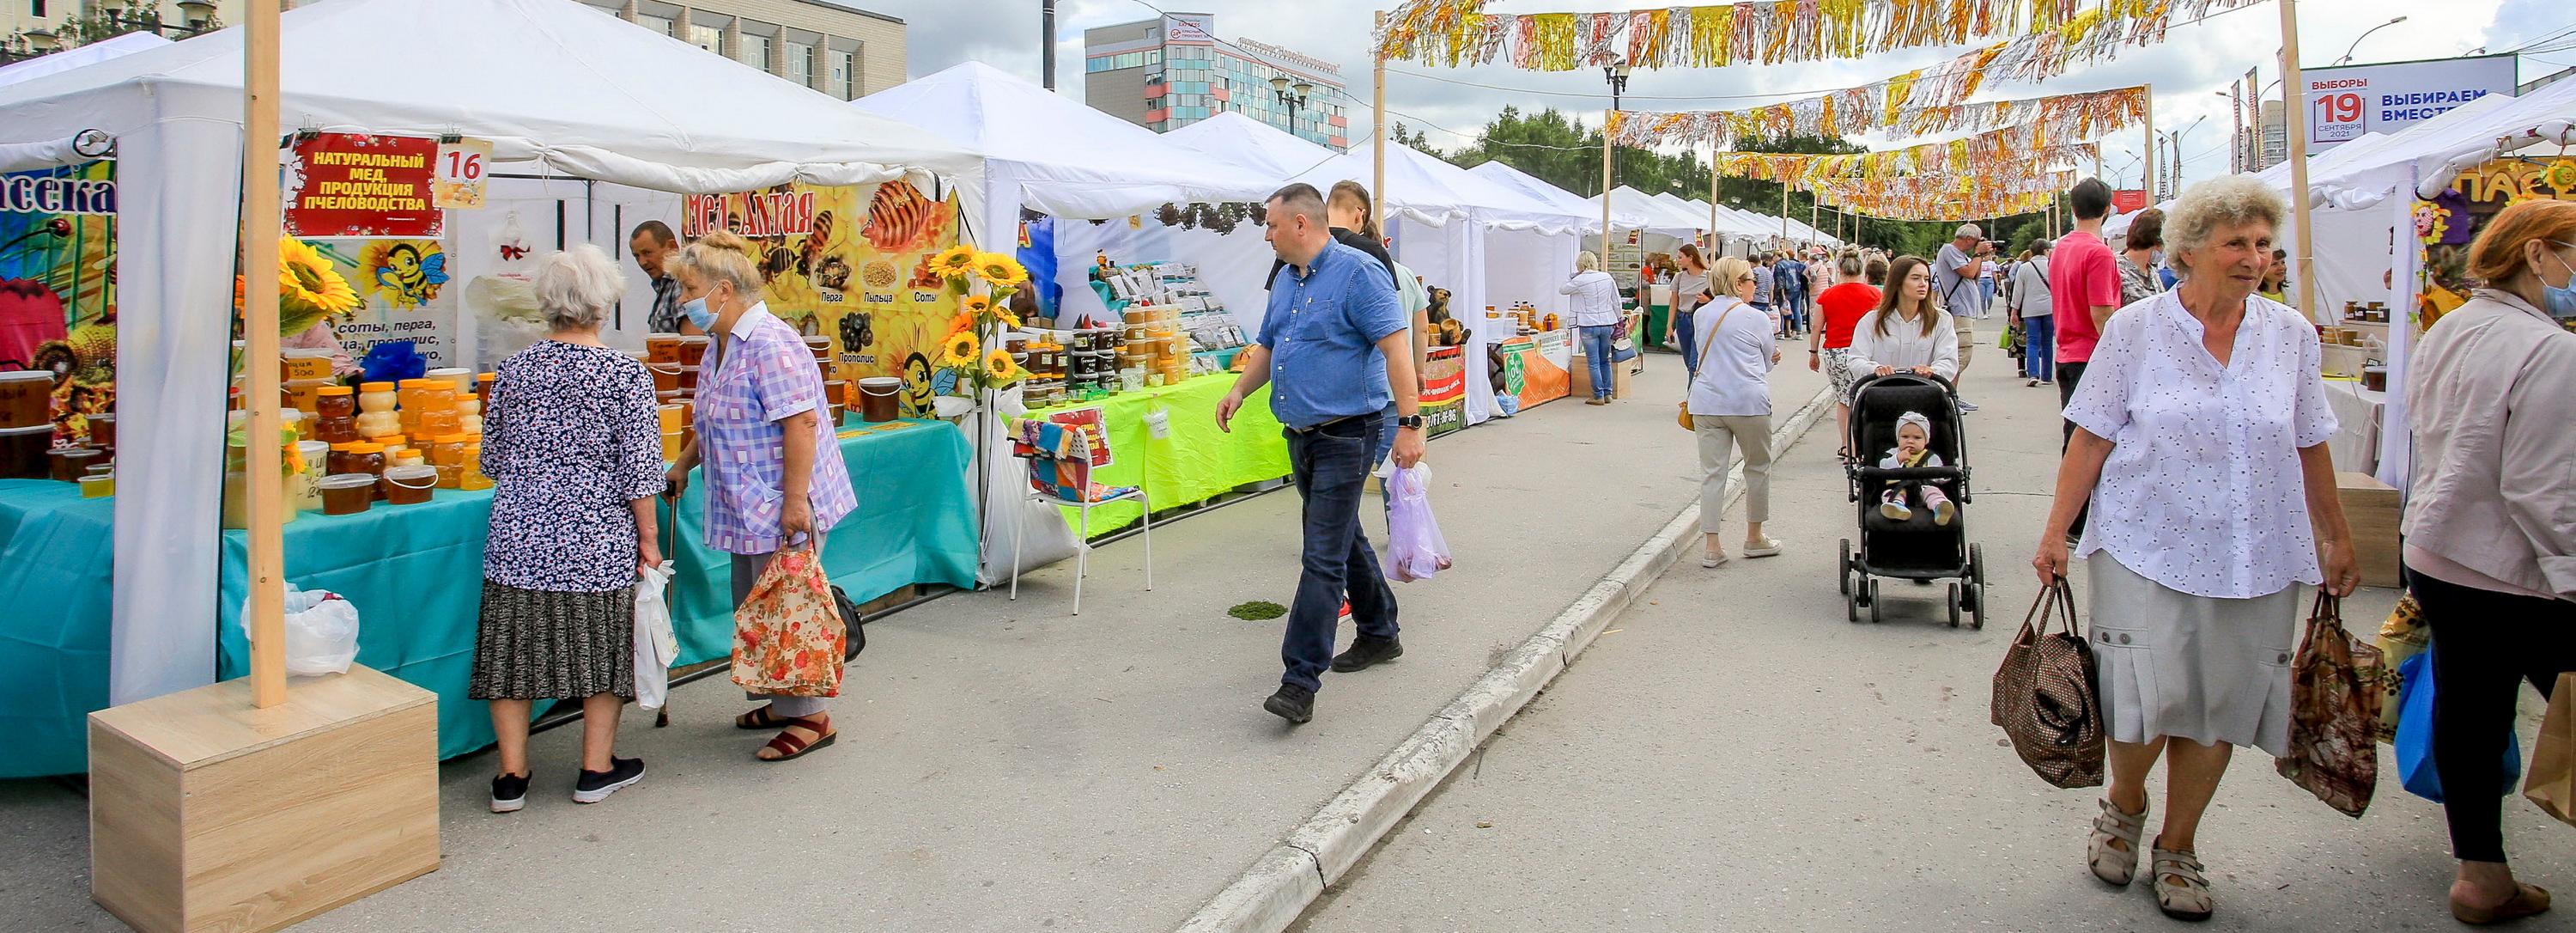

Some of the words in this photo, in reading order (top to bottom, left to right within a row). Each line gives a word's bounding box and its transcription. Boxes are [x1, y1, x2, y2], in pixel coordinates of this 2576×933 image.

[2312, 78, 2368, 90] ВЫБОРЫ
[2381, 88, 2488, 107] ВЫБИРАЕМ
[2318, 93, 2361, 123] 19
[2381, 107, 2458, 122] ВМЕСТ
[2318, 123, 2362, 132] СЕНТЯБРЯ
[313, 151, 425, 168] НАТУРАЛЬНЫЙ
[447, 150, 482, 180] 16
[349, 168, 387, 182] МЕД,
[0, 177, 118, 214] сека
[319, 181, 414, 198] ПРОДУКЦИЯ
[304, 196, 426, 212] ПЧЕЛОВОДСТВА
[738, 191, 815, 237] Алтая
[821, 291, 844, 304] Перга
[864, 291, 893, 304] Пыльца
[914, 291, 938, 302] Соты
[337, 322, 389, 334] соты,
[393, 320, 436, 334] перга,
[837, 351, 875, 364] Прополис
[294, 369, 315, 377] 500
